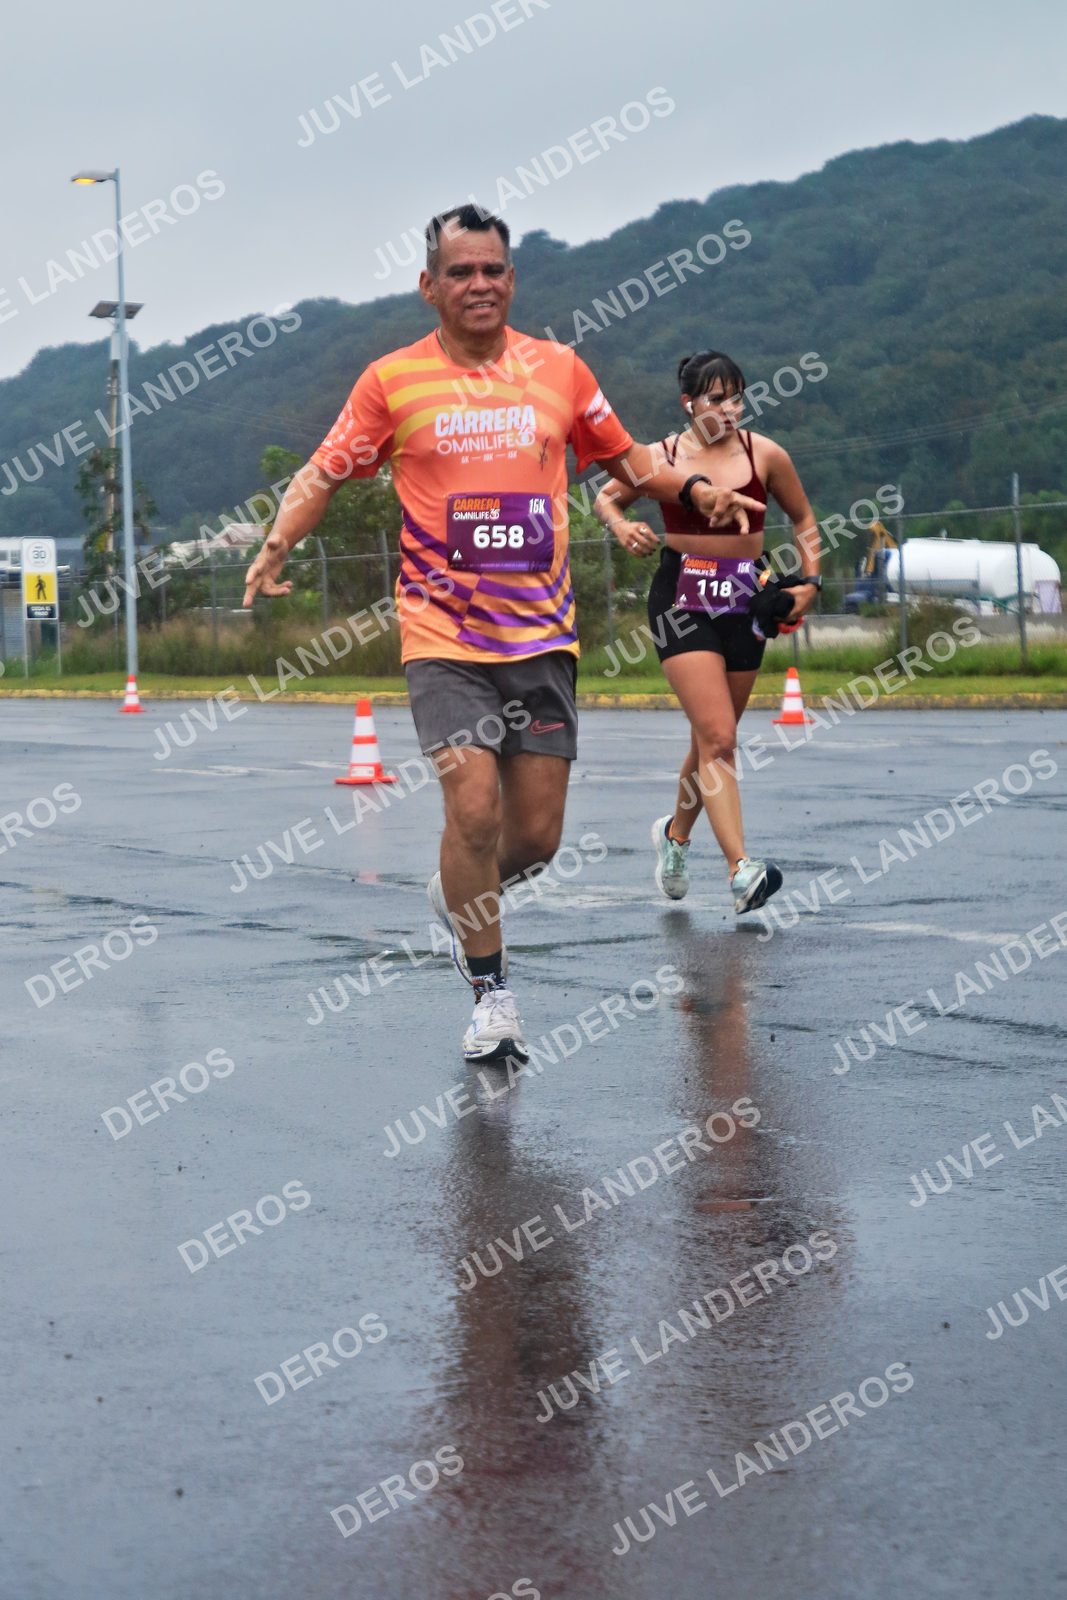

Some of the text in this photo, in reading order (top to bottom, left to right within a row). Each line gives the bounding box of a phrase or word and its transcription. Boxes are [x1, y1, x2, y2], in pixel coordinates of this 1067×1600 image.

[435, 405, 536, 437] CARRERA
[453, 498, 501, 511] CARRERA
[473, 524, 525, 549] 658
[697, 579, 732, 598] 118
